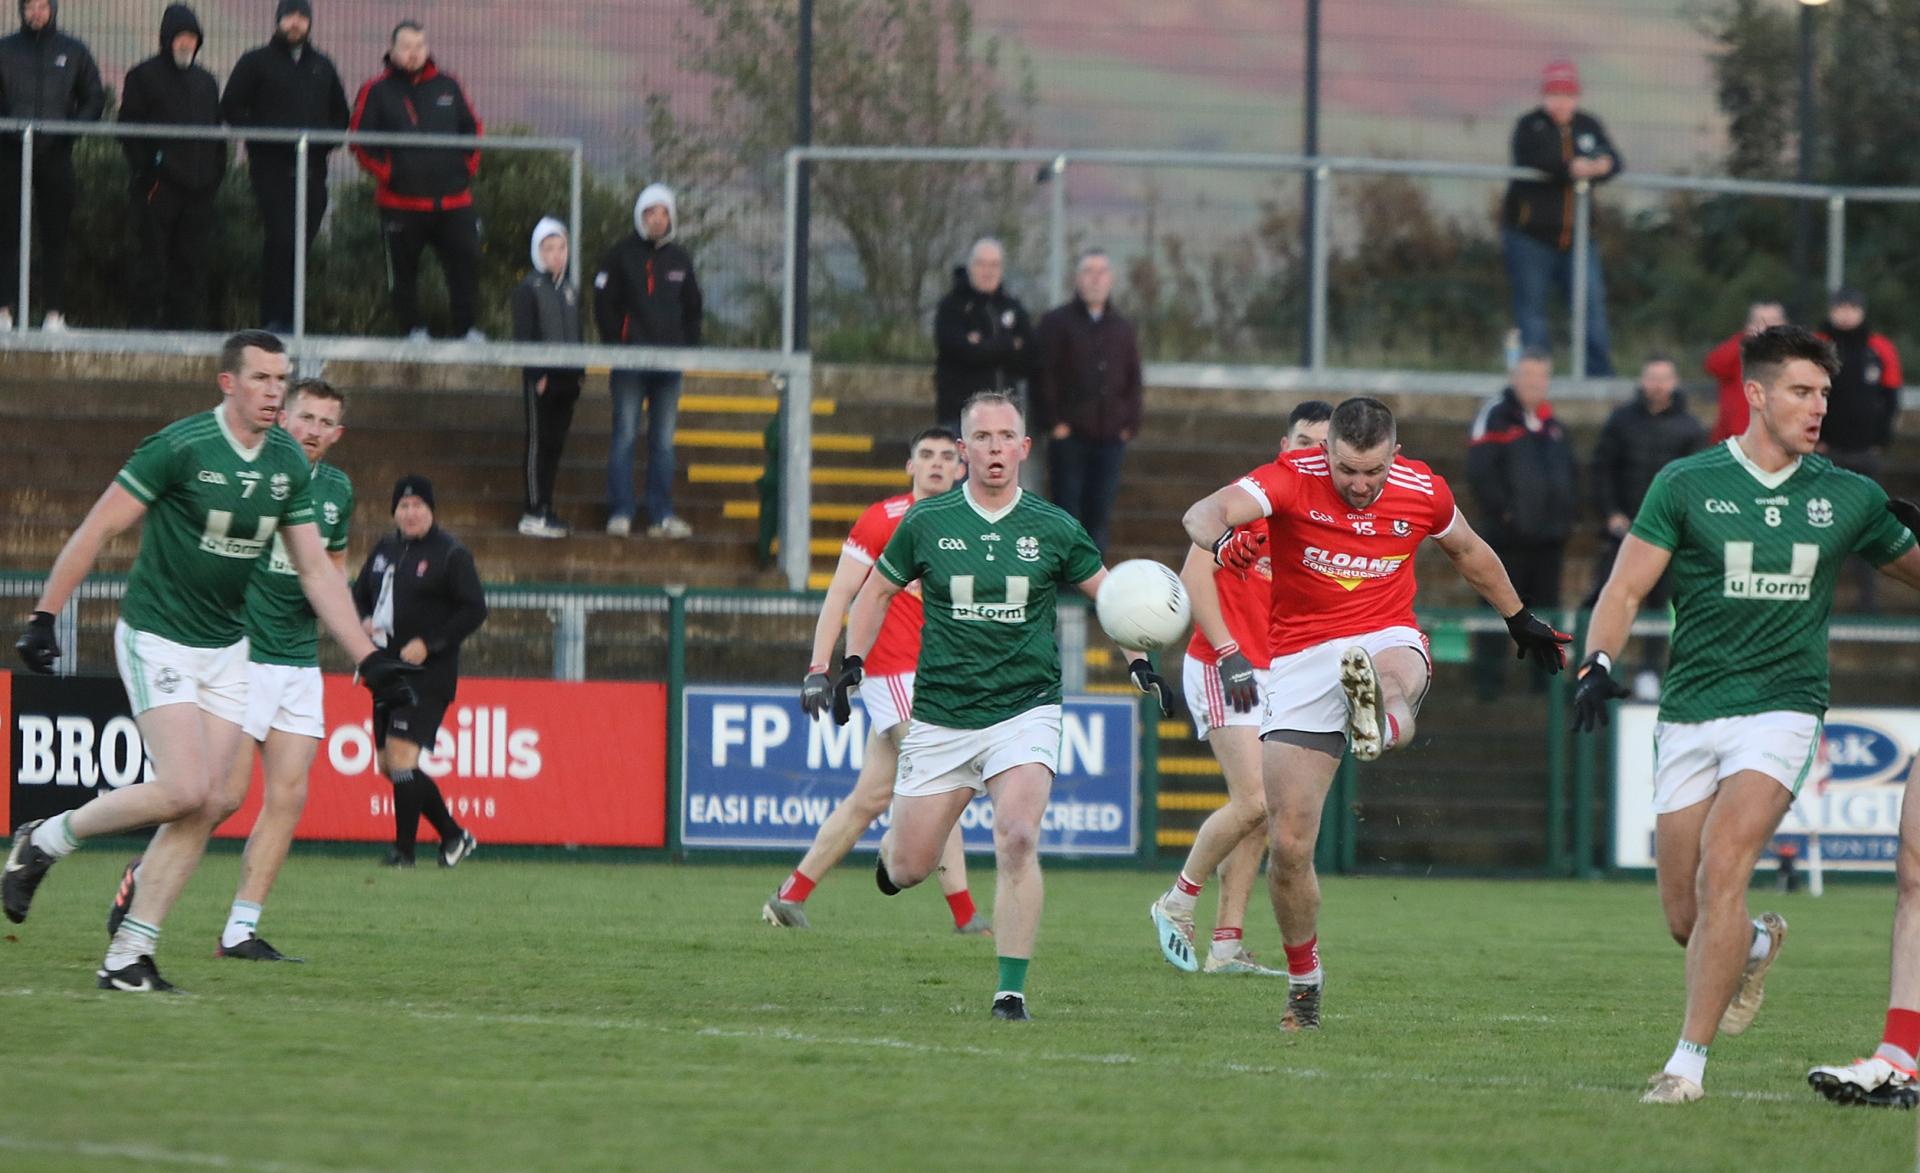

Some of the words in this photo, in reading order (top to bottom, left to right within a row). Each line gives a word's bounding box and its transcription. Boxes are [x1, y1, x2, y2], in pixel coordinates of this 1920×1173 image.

[241, 480, 257, 498] 7
[1706, 498, 1741, 514] GAA
[1764, 506, 1782, 527] 8
[1352, 521, 1376, 536] 15
[938, 538, 967, 550] GAA
[1303, 546, 1402, 572] CLOANE
[1730, 581, 1744, 593] u
[1756, 578, 1807, 595] form
[977, 606, 1021, 619] form
[328, 706, 542, 780] o'eills
[712, 704, 791, 768] FP
[18, 715, 157, 788] BRO
[448, 796, 495, 818] 1918
[690, 794, 749, 824] EASI
[753, 796, 829, 826] FLOW
[1041, 803, 1123, 832] CREED
